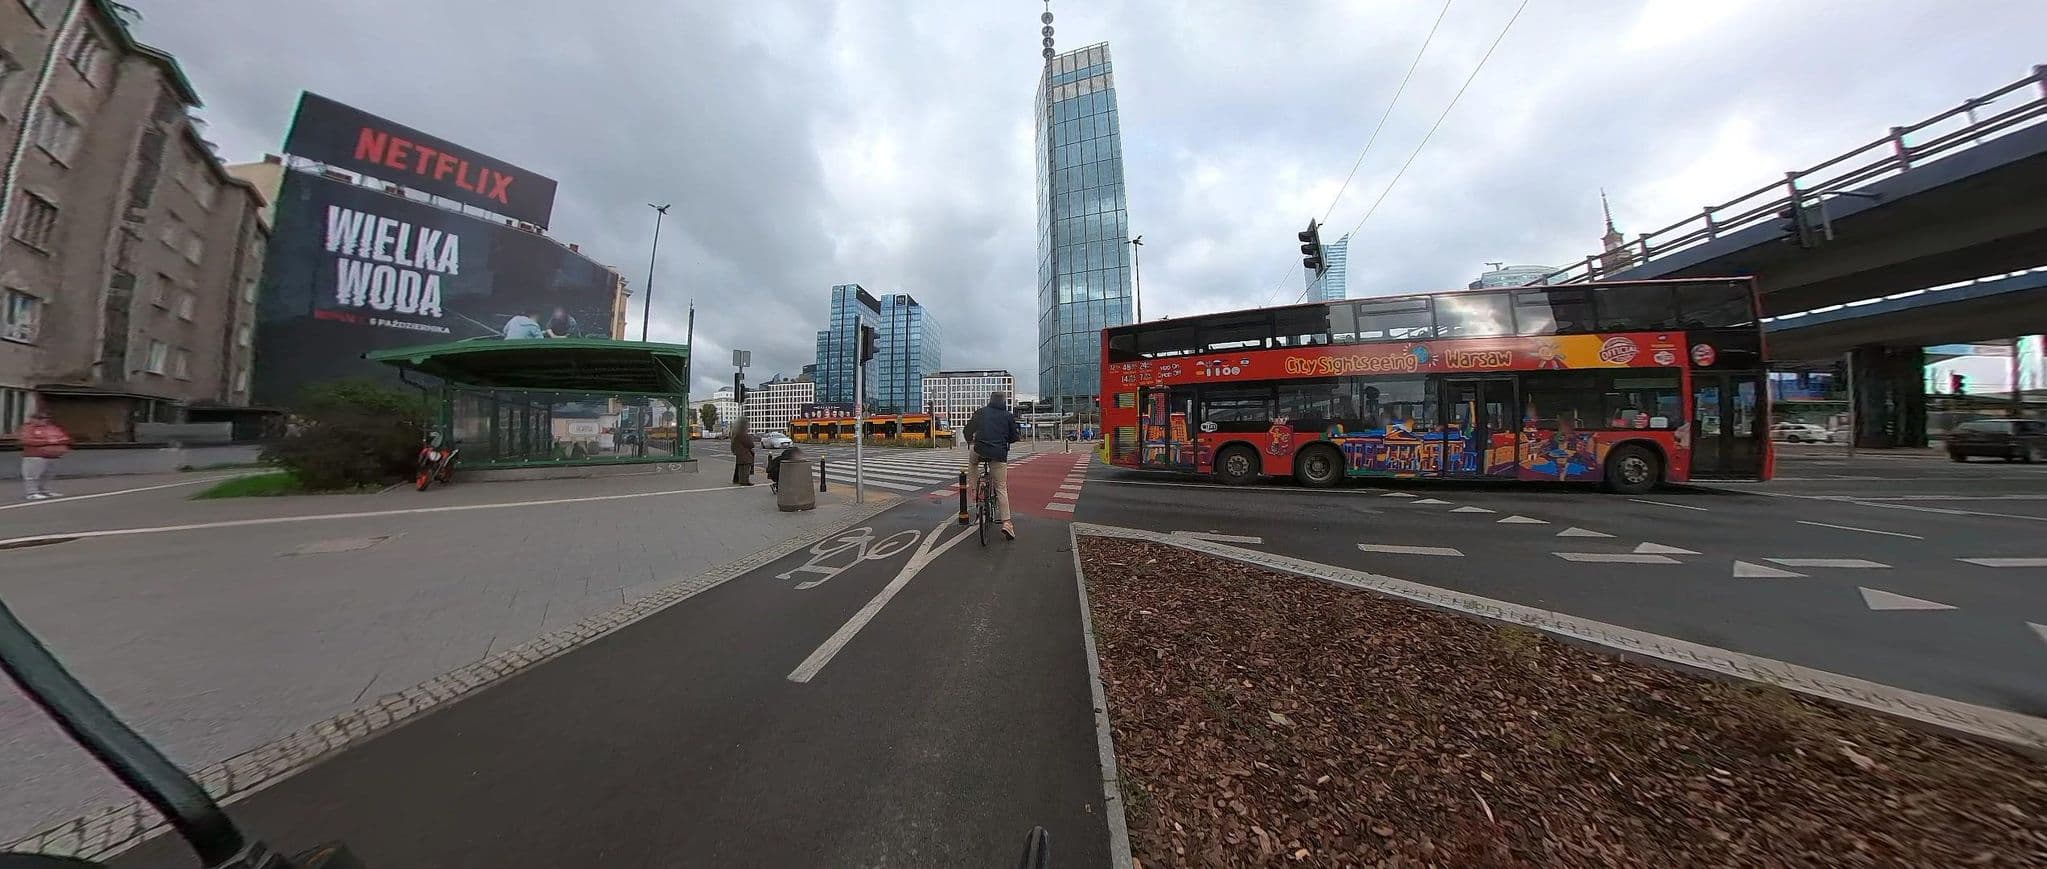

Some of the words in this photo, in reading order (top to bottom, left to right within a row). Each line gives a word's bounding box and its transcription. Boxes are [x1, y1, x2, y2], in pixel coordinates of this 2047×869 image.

[354, 127, 514, 204] NETFLIX
[325, 205, 459, 275] WIELKA
[335, 257, 443, 318] WODA
[1445, 350, 1512, 368] Warsaw
